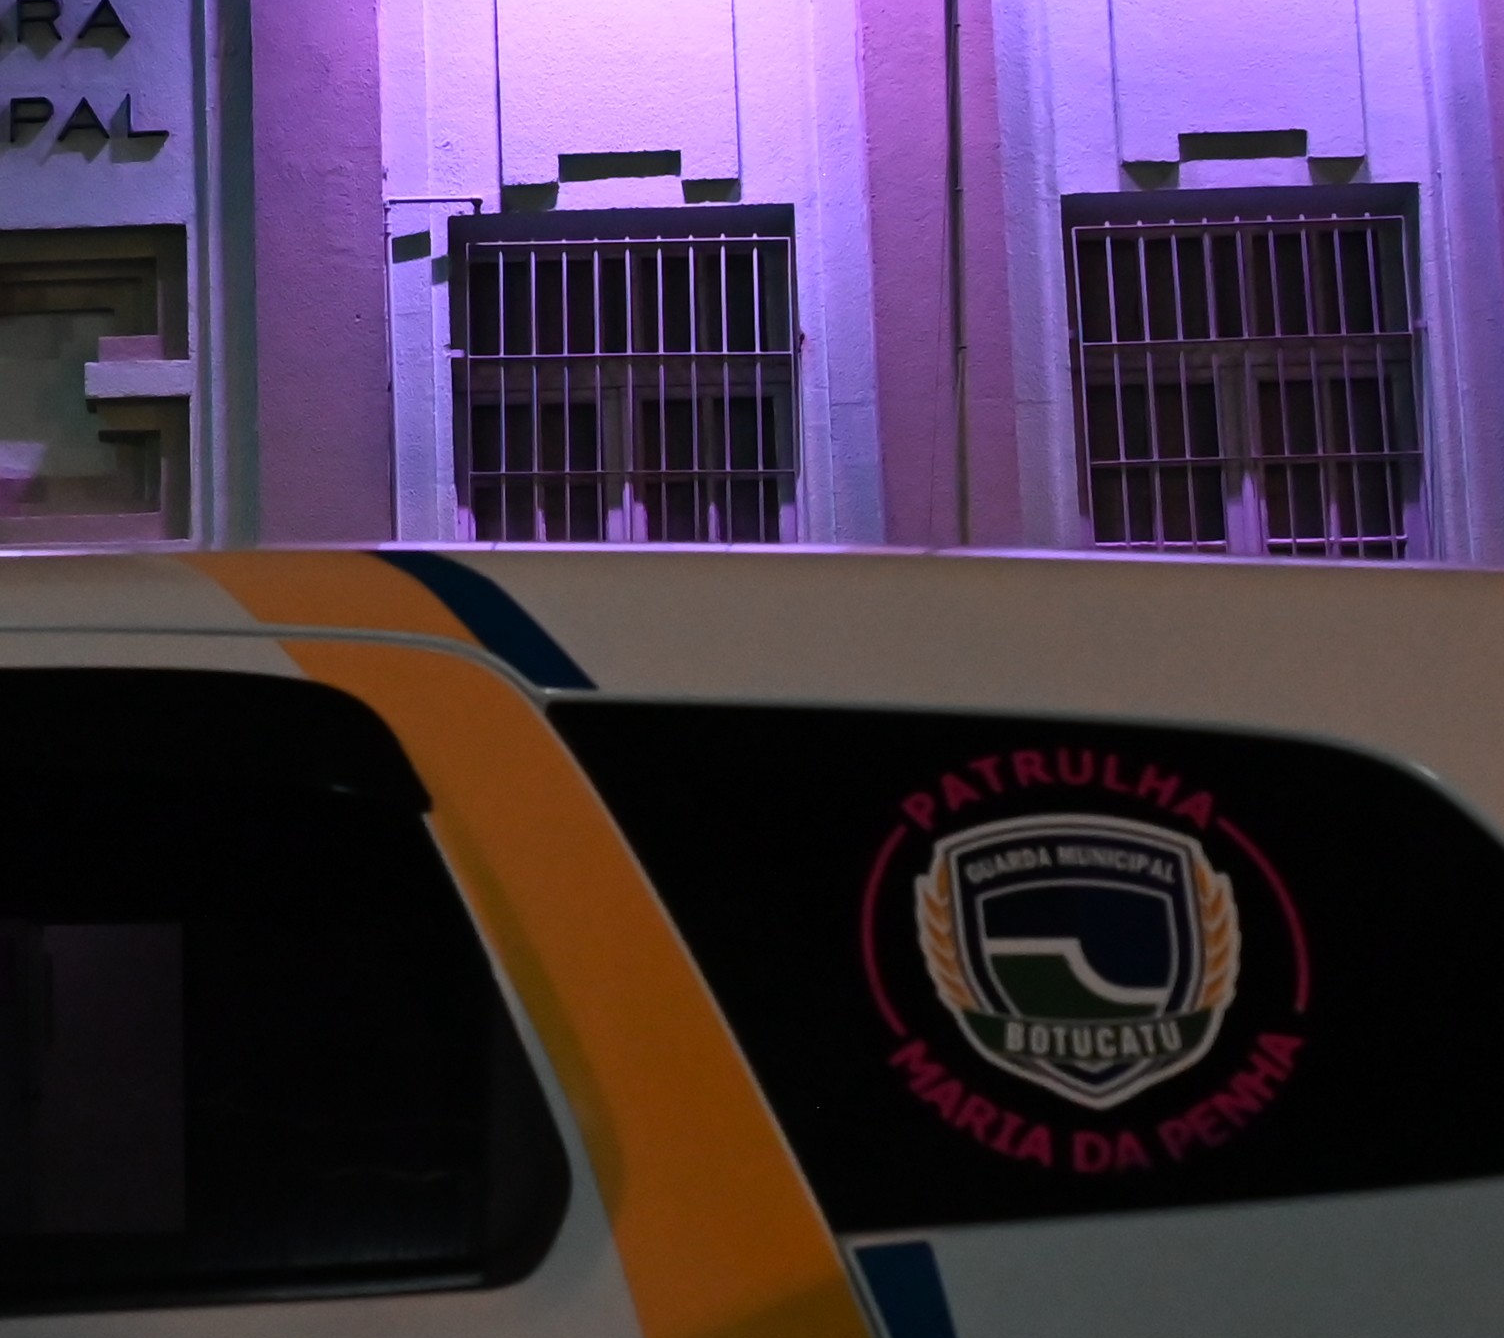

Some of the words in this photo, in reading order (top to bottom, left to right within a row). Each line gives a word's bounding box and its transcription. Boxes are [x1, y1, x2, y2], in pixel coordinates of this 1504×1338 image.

[901, 748, 1218, 831] PATRULHA
[964, 845, 1053, 885] GUARDA
[1055, 845, 1177, 885] MUNICIPAL
[1004, 1021, 1183, 1059] BOTUCATU
[889, 1039, 1054, 1167] MARIA
[1072, 1131, 1153, 1173] DA
[1156, 1032, 1307, 1159] PENHA
